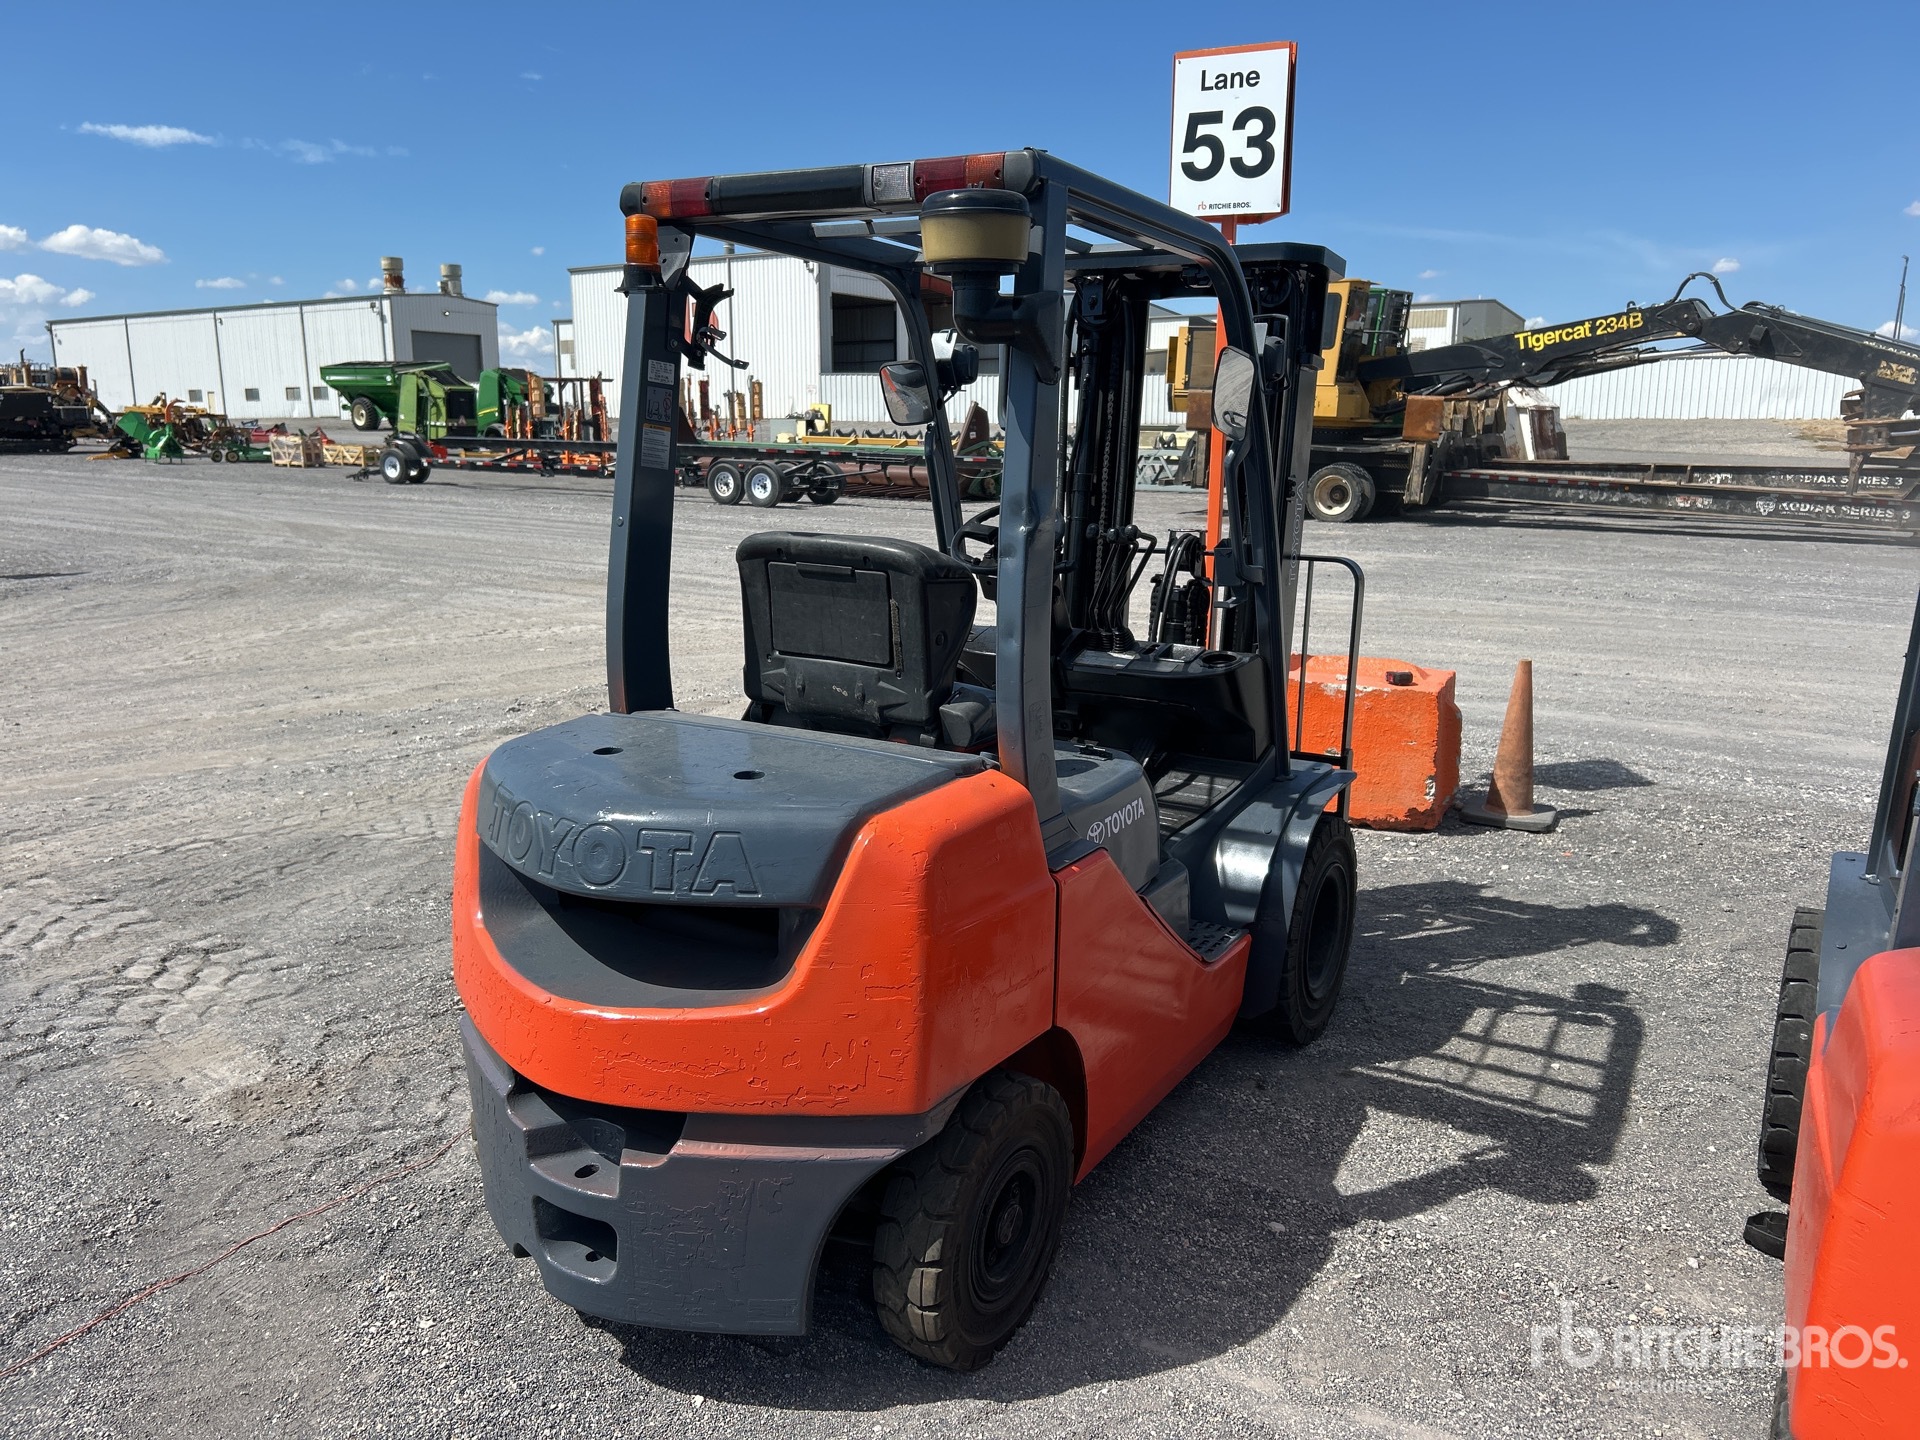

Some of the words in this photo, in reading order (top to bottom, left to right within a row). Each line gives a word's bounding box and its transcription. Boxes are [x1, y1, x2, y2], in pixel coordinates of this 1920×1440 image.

[1201, 69, 1261, 91] Lane
[1180, 105, 1276, 182] 53
[1514, 321, 1592, 352] Tigercat
[1596, 312, 1644, 336] 234B
[1786, 474, 1836, 484] KDIAK
[1840, 475, 1889, 485] SRIES
[1894, 476, 1904, 485] 3
[1778, 501, 1836, 514] KODIAK
[1840, 504, 1894, 518] SERIES
[1902, 509, 1911, 519] 3
[1104, 797, 1145, 838] TOYOTA
[489, 781, 763, 898] TOYOTA
